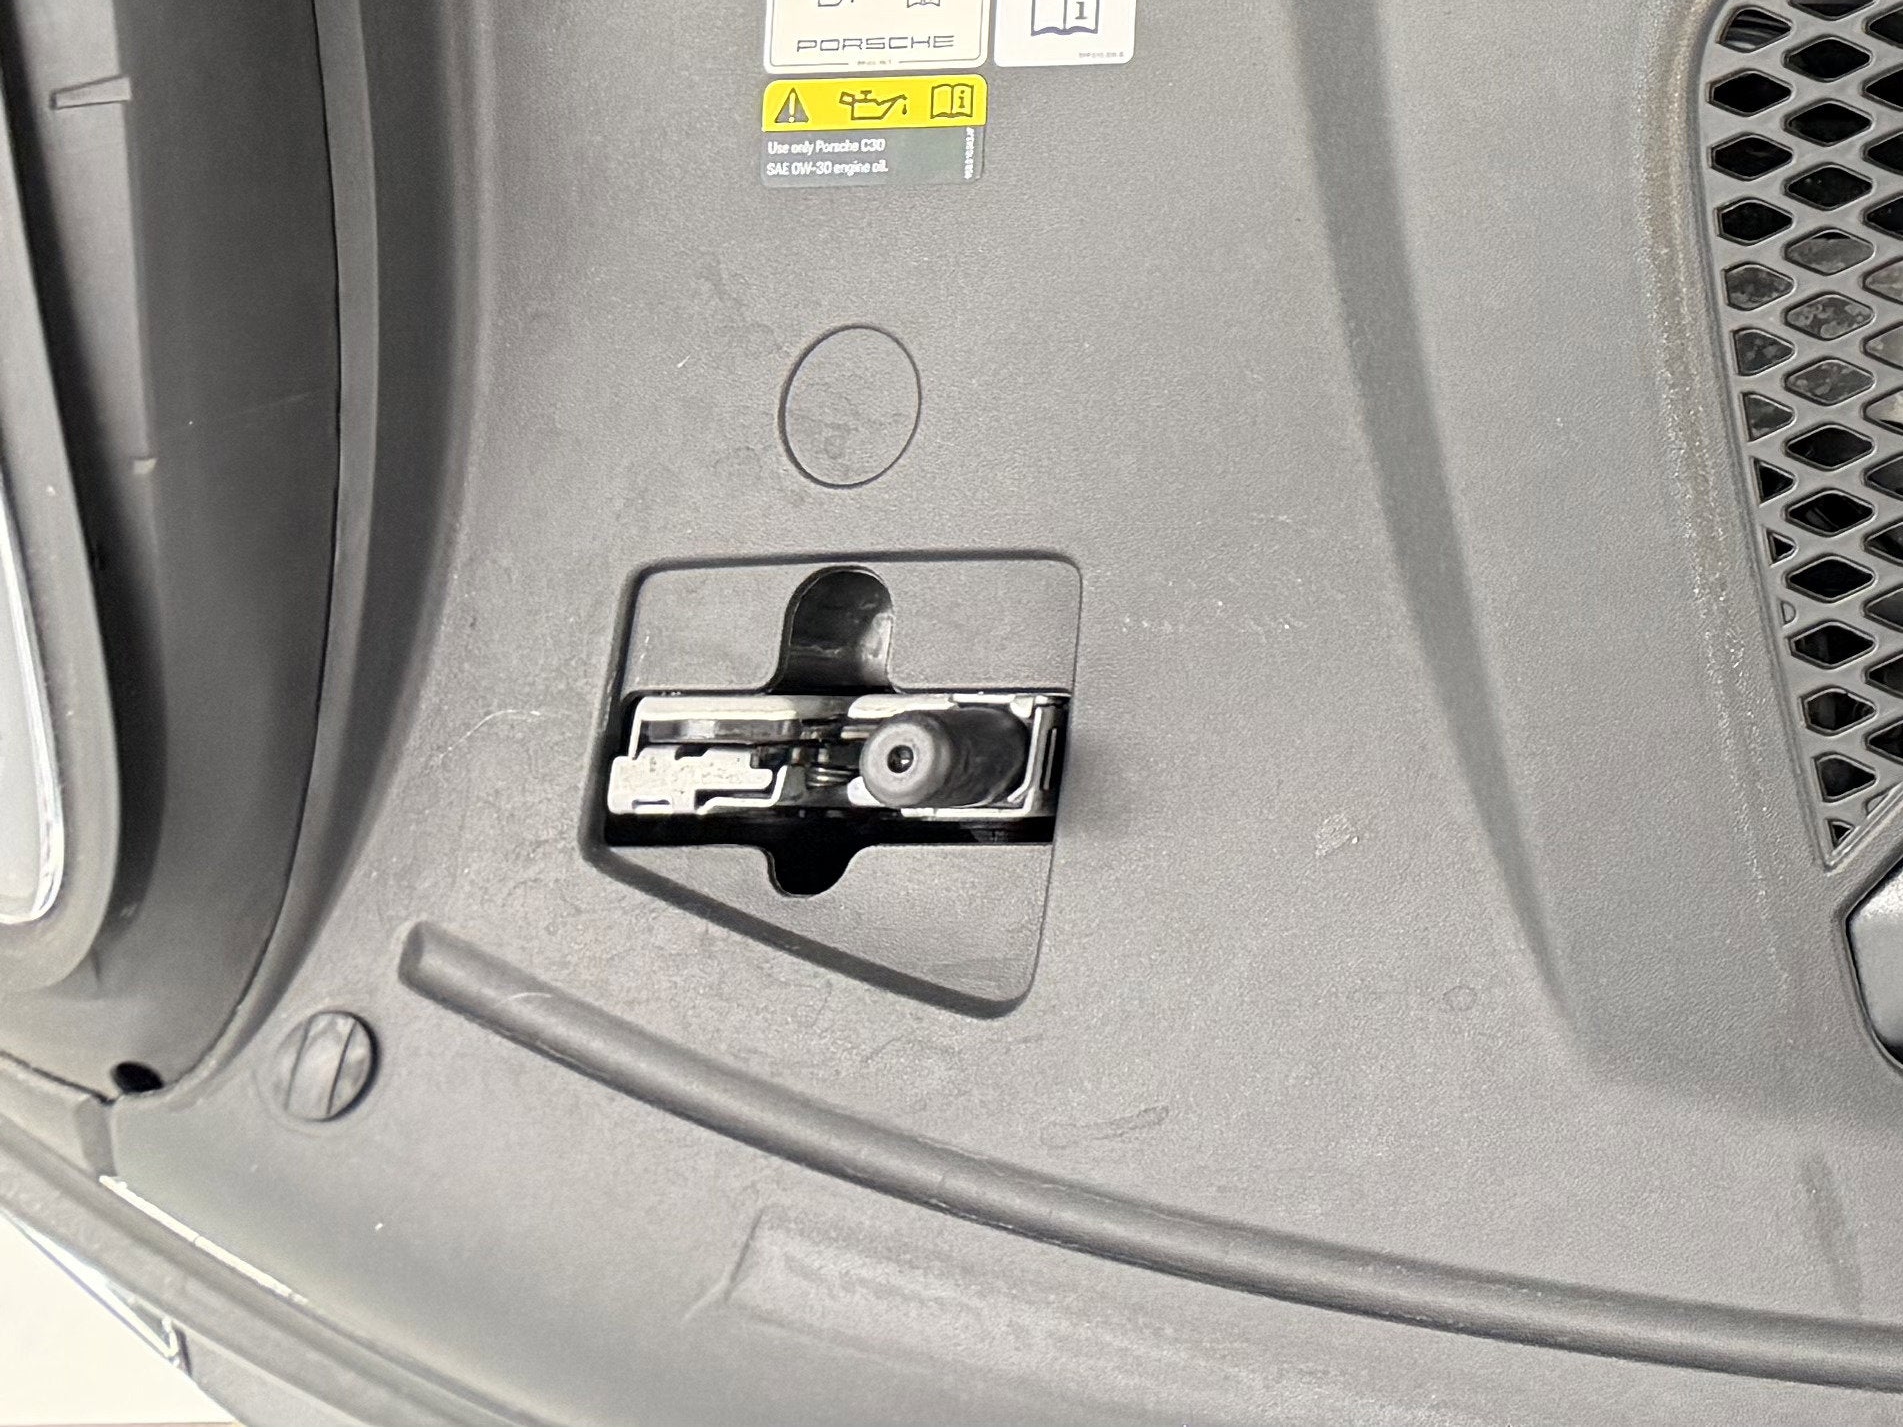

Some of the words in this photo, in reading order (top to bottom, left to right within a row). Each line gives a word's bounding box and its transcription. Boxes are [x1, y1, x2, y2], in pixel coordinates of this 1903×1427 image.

[796, 35, 955, 53] PORSCHE
[767, 140, 789, 155] Use
[790, 139, 815, 156] only
[815, 139, 860, 154] Porsche
[860, 138, 886, 152] C30
[766, 161, 790, 176] SAE
[790, 160, 832, 176] 0W-30
[833, 161, 870, 177] engine
